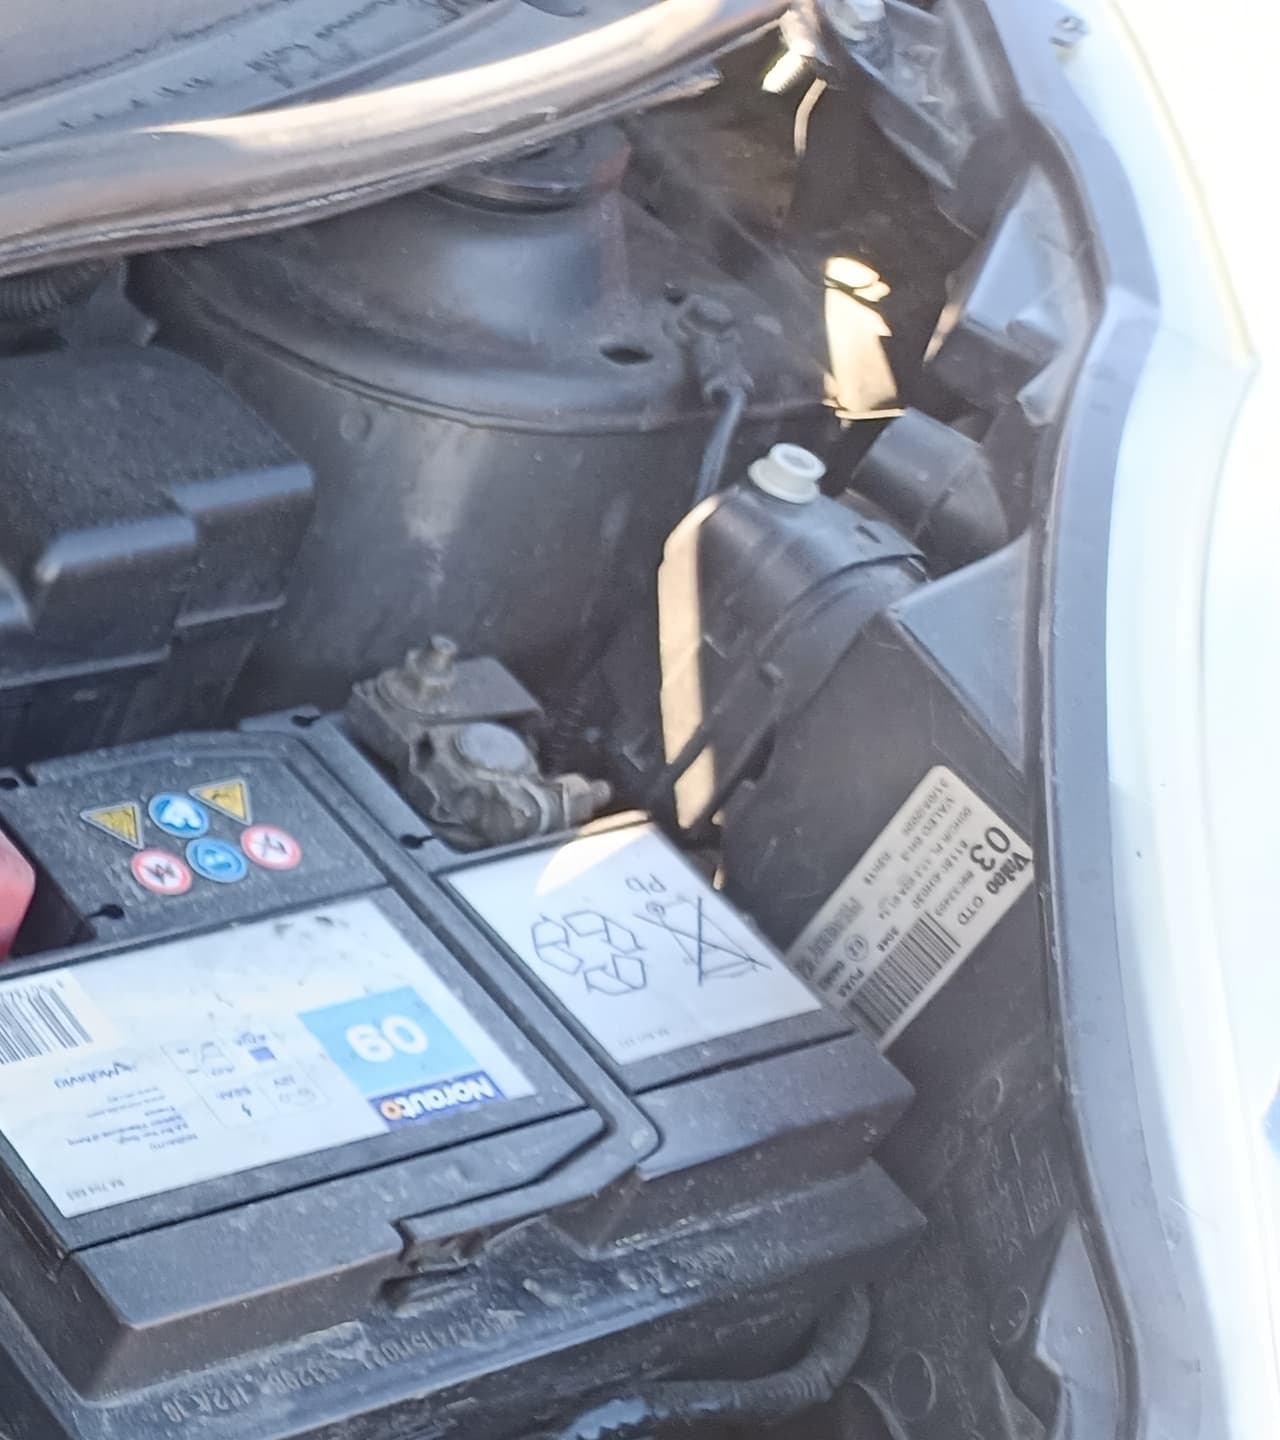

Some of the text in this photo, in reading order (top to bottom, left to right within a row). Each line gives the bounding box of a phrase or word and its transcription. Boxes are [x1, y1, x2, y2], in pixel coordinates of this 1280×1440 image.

[969, 826, 1011, 871] 03
[624, 872, 667, 896] Pb
[986, 851, 1032, 894] Valeo
[380, 1074, 496, 1121] Norauto
